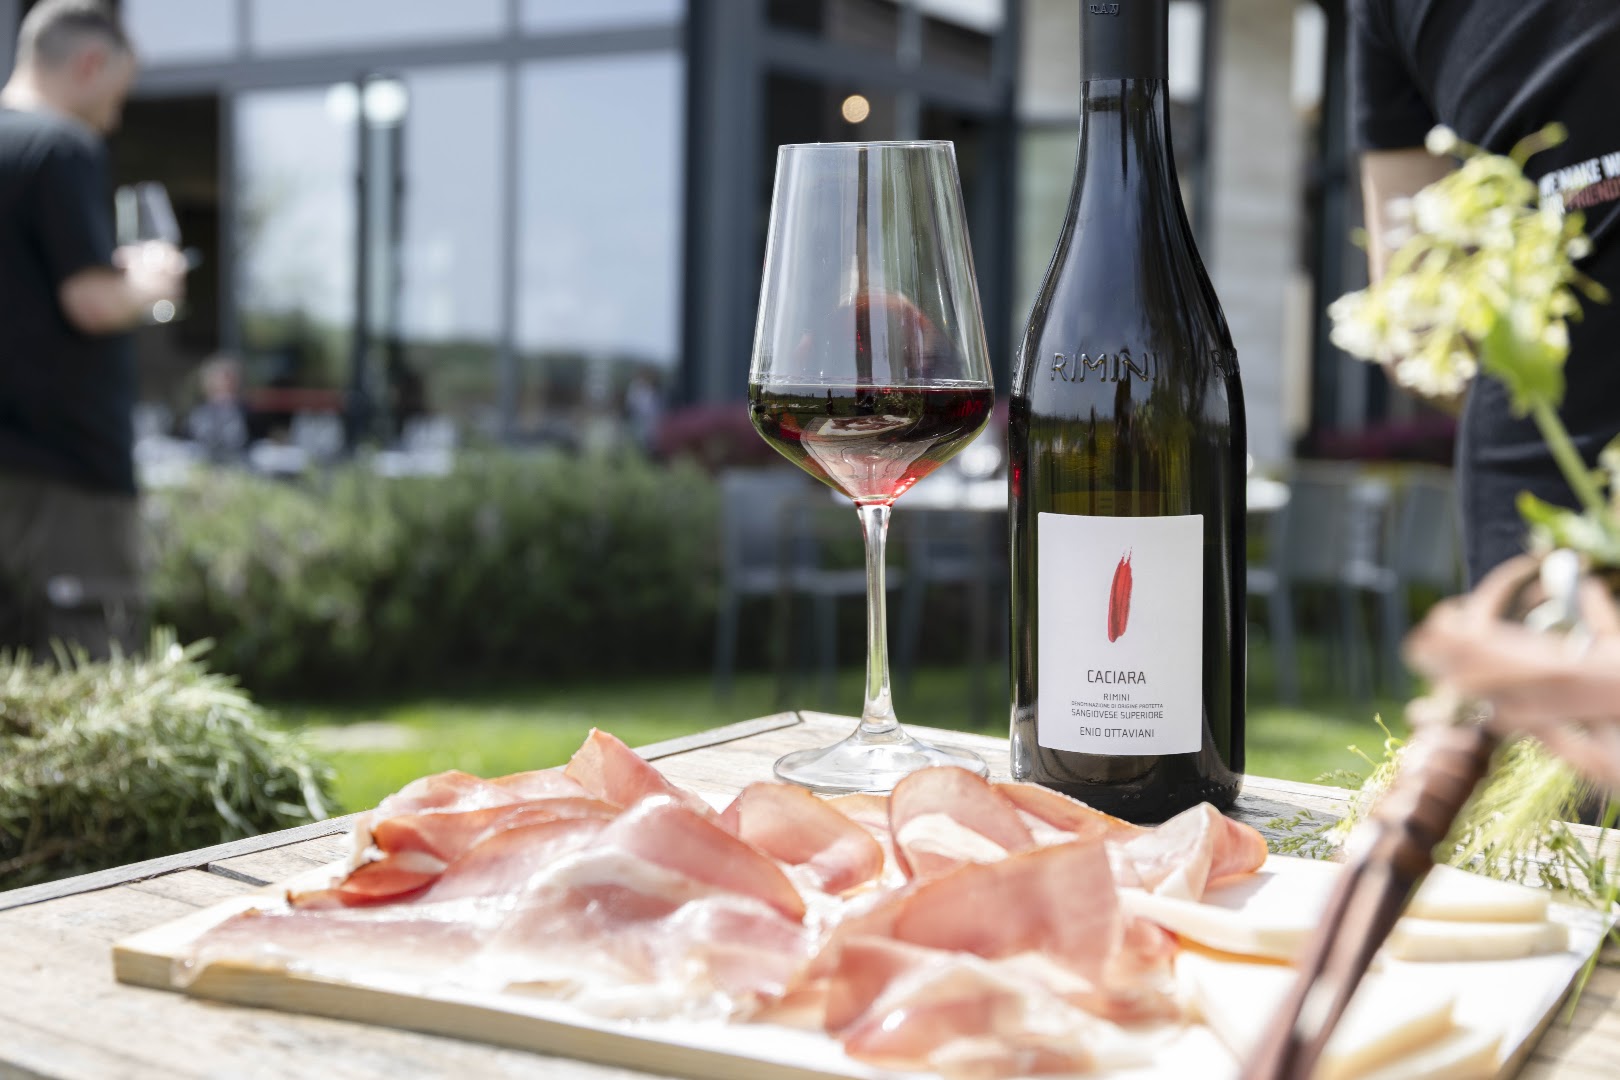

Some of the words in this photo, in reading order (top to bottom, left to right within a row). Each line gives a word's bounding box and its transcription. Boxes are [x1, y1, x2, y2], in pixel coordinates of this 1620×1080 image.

[1557, 158, 1602, 191] MAKE
[1050, 352, 1159, 383] RIMINI
[1087, 669, 1147, 685] CACIARA
[1103, 693, 1130, 702] RIMINI
[1071, 700, 1110, 709] DENOMINAZIONE
[1071, 708, 1118, 719] SANGIOVESE
[1120, 711, 1164, 720] SUPERIORE
[1080, 726, 1102, 737] ENIO
[1104, 728, 1155, 738] OTTAVIANI
